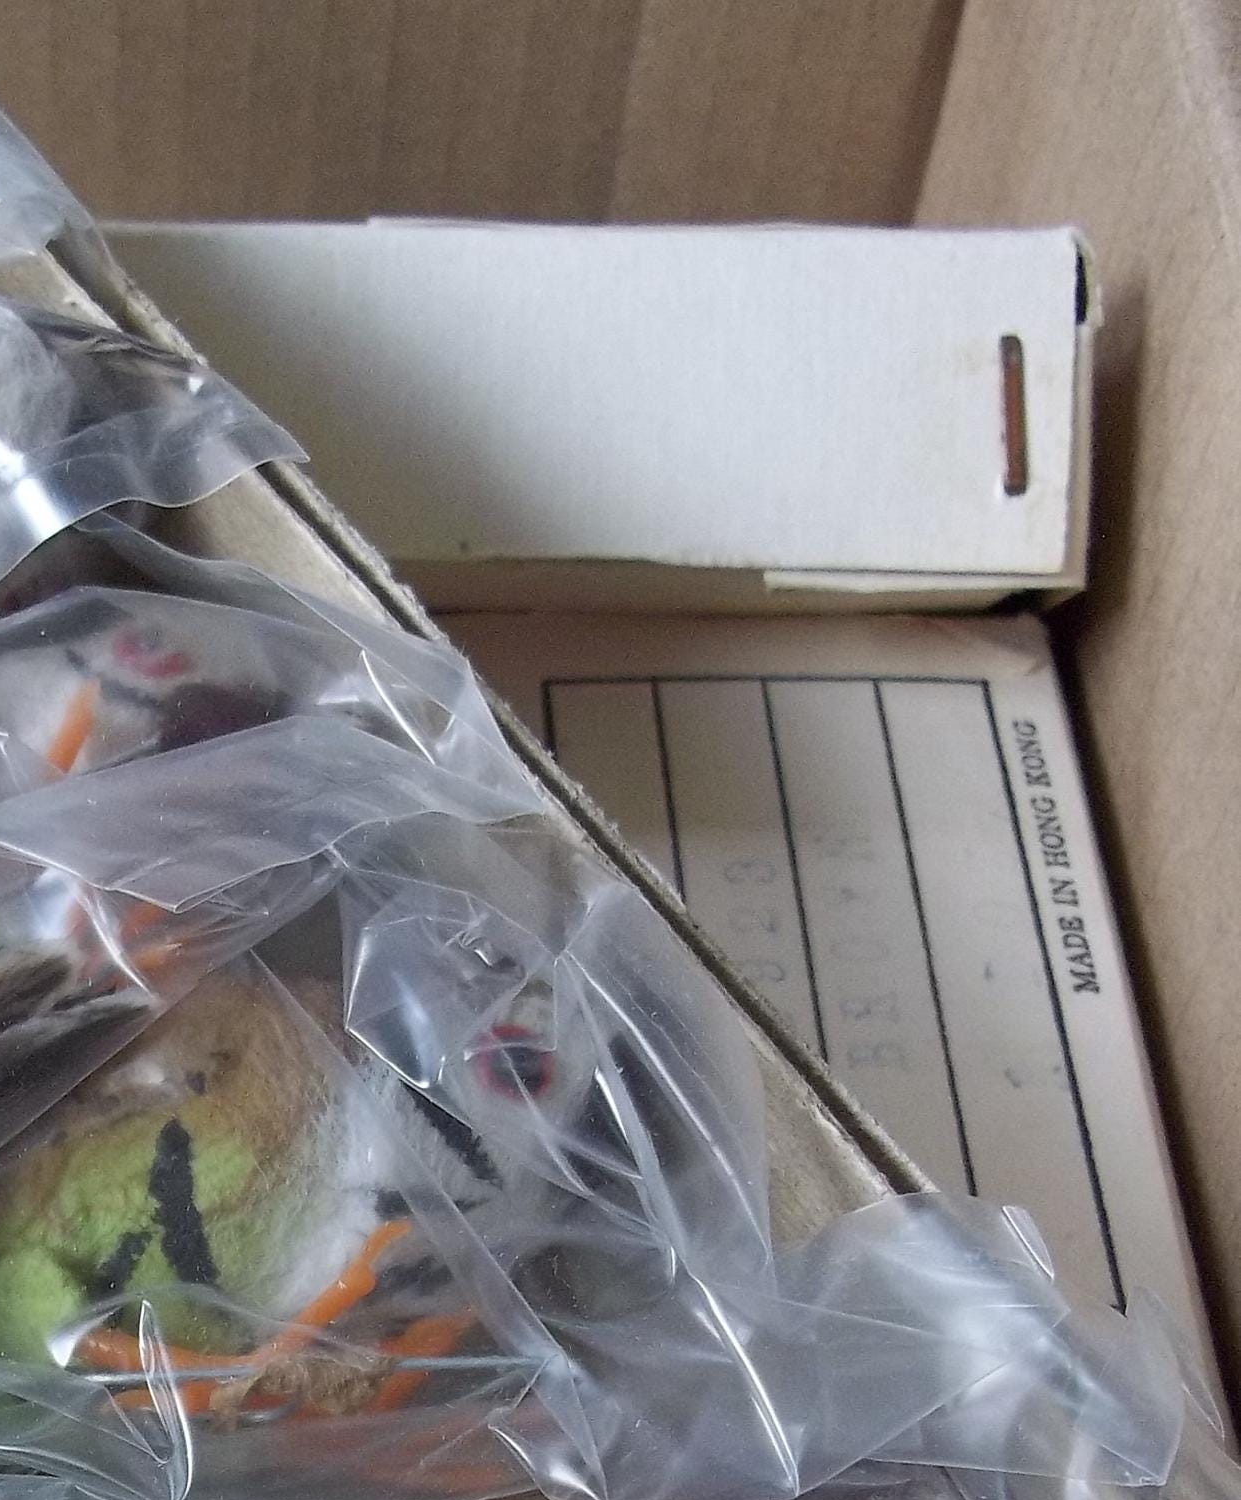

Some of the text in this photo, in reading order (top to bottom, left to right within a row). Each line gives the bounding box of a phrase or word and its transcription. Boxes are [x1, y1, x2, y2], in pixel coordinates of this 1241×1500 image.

[1012, 718, 1102, 995] MADE IN HONG KONG
